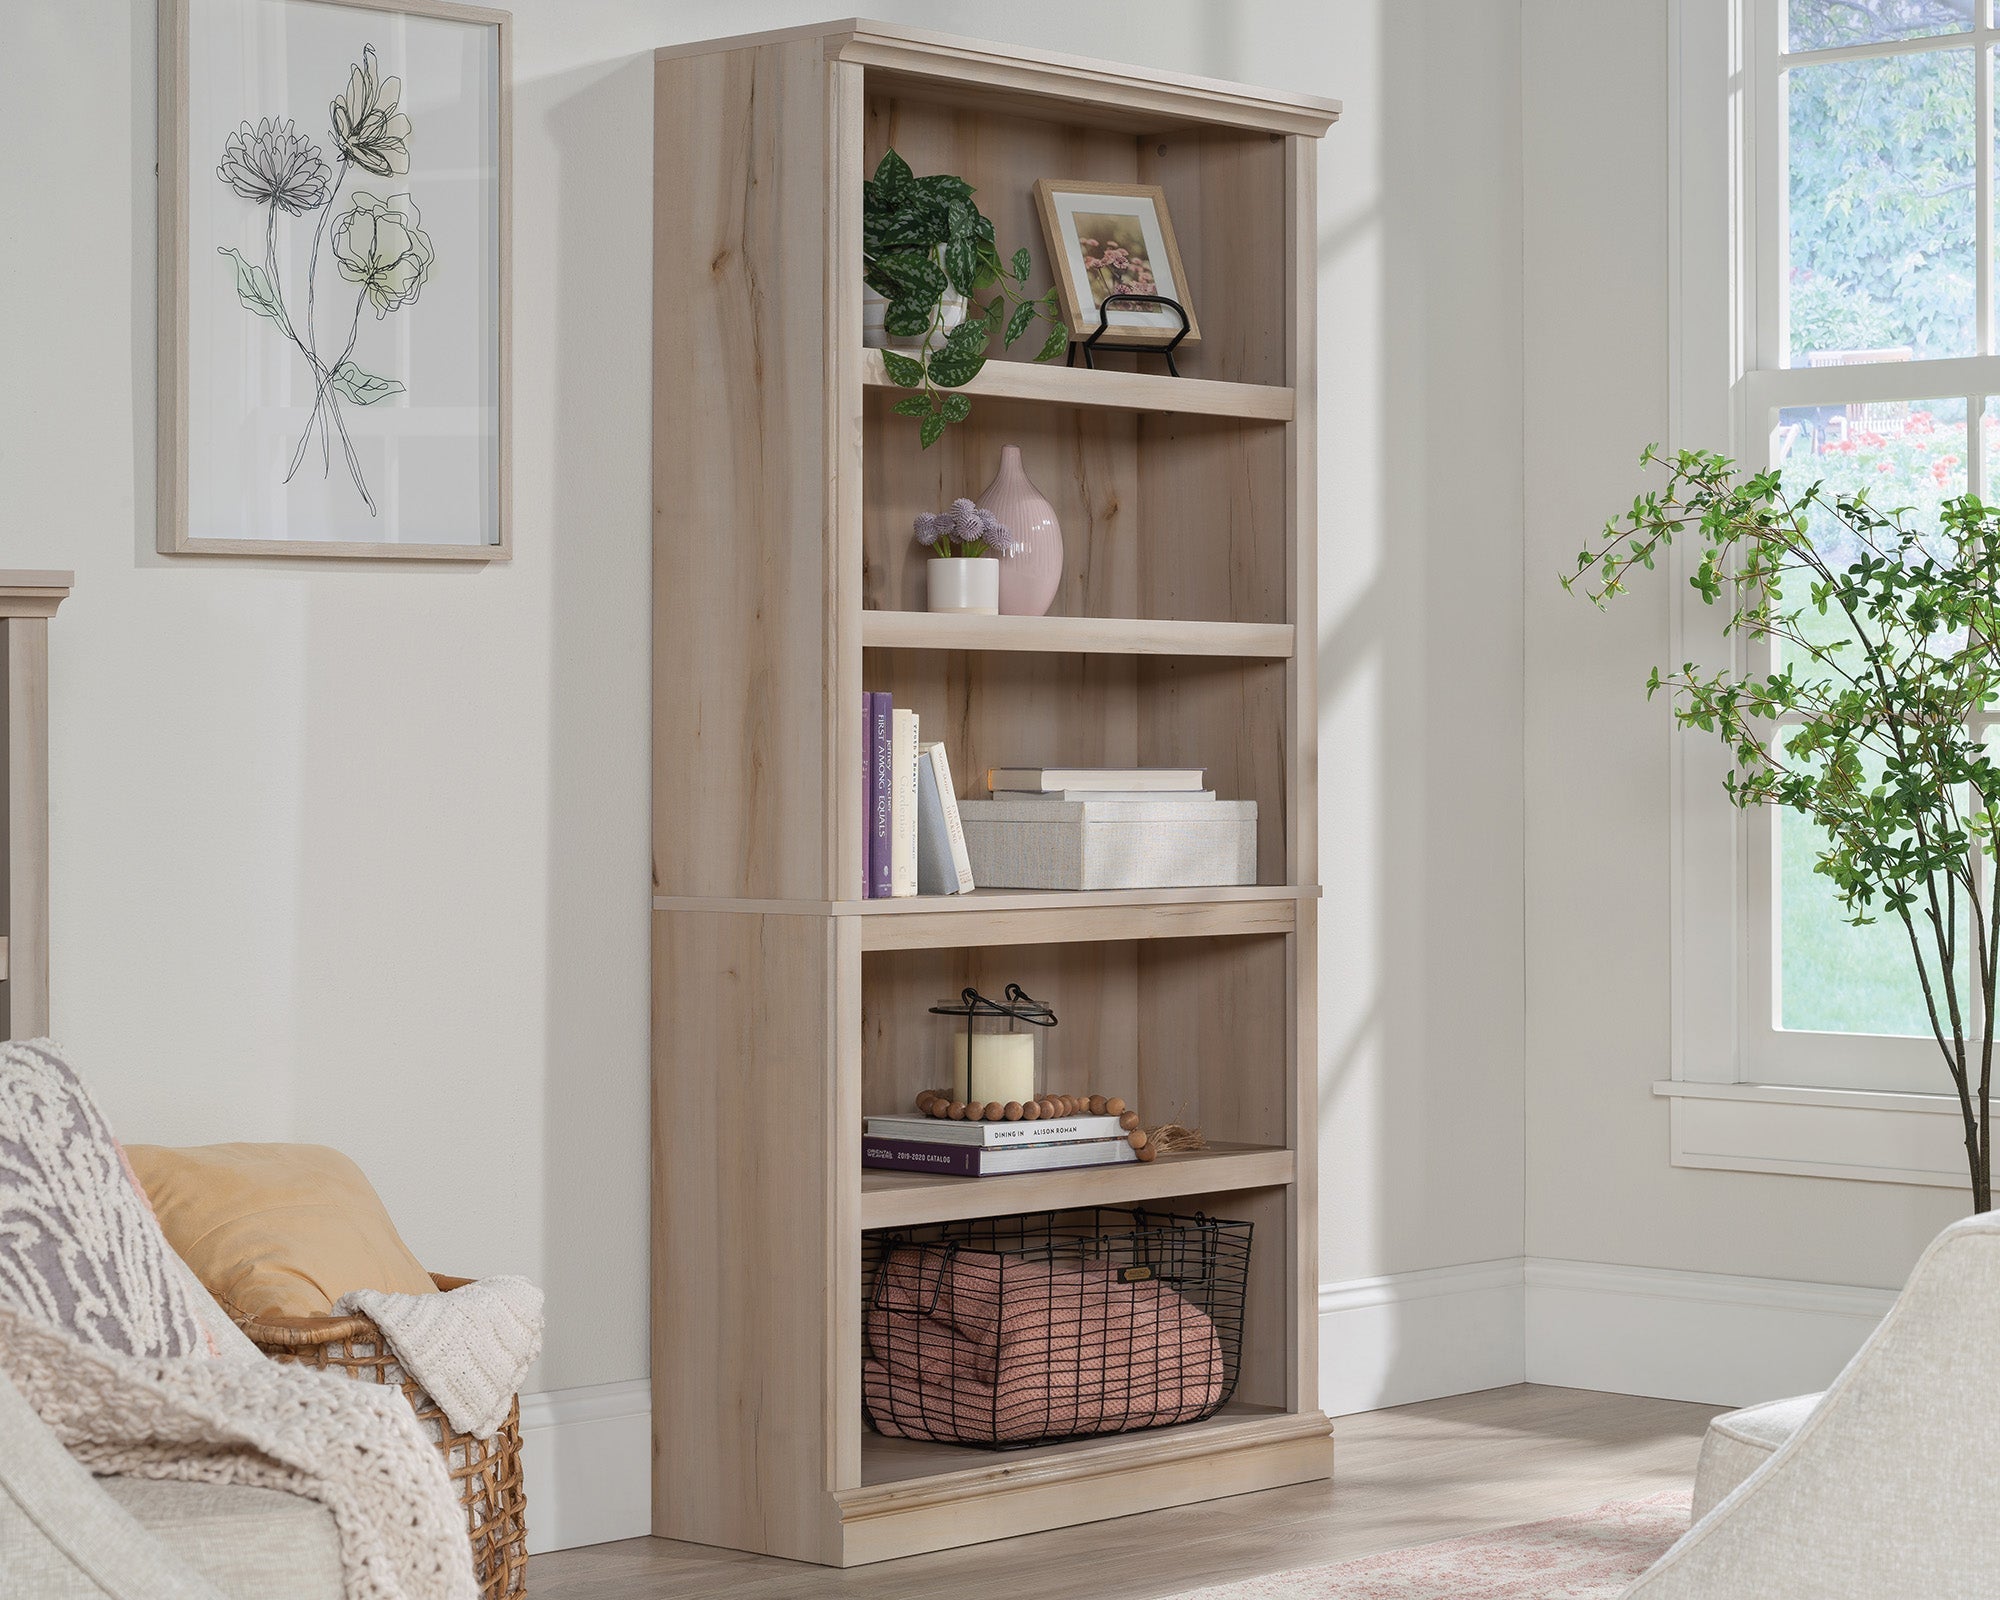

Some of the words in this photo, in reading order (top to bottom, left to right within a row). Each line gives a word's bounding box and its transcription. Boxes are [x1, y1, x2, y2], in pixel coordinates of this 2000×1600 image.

[877, 795, 886, 838] EQUALS
[900, 776, 909, 839] Gardenias
[946, 806, 959, 845] THINKING
[994, 1131, 1016, 1139] DINING
[1018, 1129, 1024, 1137] IN
[1033, 1128, 1055, 1136] ALISON
[897, 1152, 926, 1161] 2019-2020
[926, 1154, 951, 1164] CATALOG
